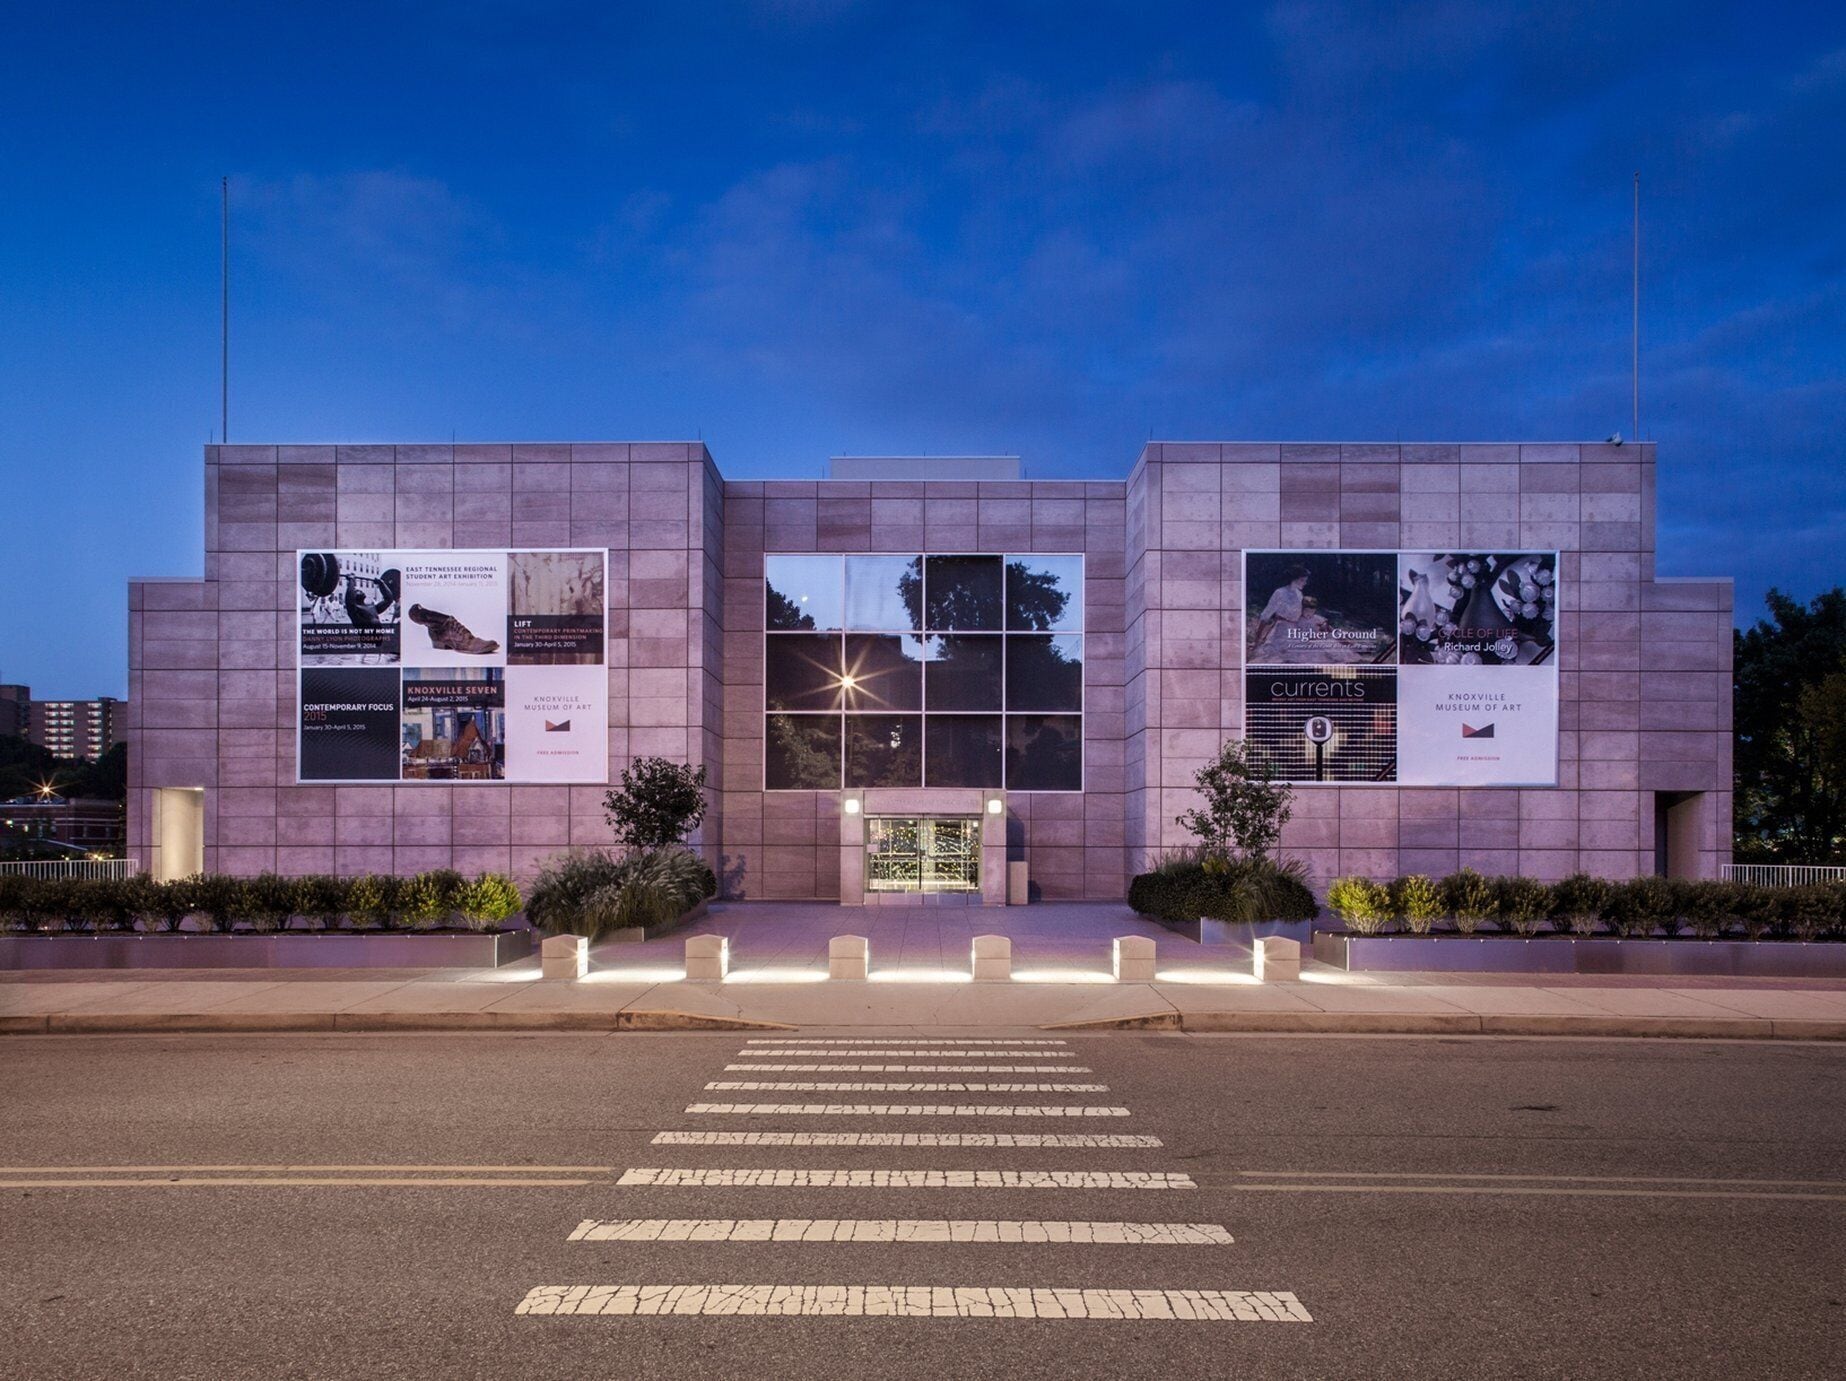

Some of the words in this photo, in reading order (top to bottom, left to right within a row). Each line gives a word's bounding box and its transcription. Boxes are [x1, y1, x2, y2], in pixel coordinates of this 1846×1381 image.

[1287, 628, 1328, 641] Higher
[1331, 628, 1376, 639] Ground
[1477, 628, 1493, 638] OF
[1496, 628, 1518, 638] LIFE
[1444, 642, 1480, 651] Richard
[1483, 642, 1512, 654] Jolley
[407, 686, 462, 694] KNOXVILLE
[466, 686, 497, 694] SEVEN
[1271, 680, 1365, 696] currents
[304, 711, 327, 720] 2015
